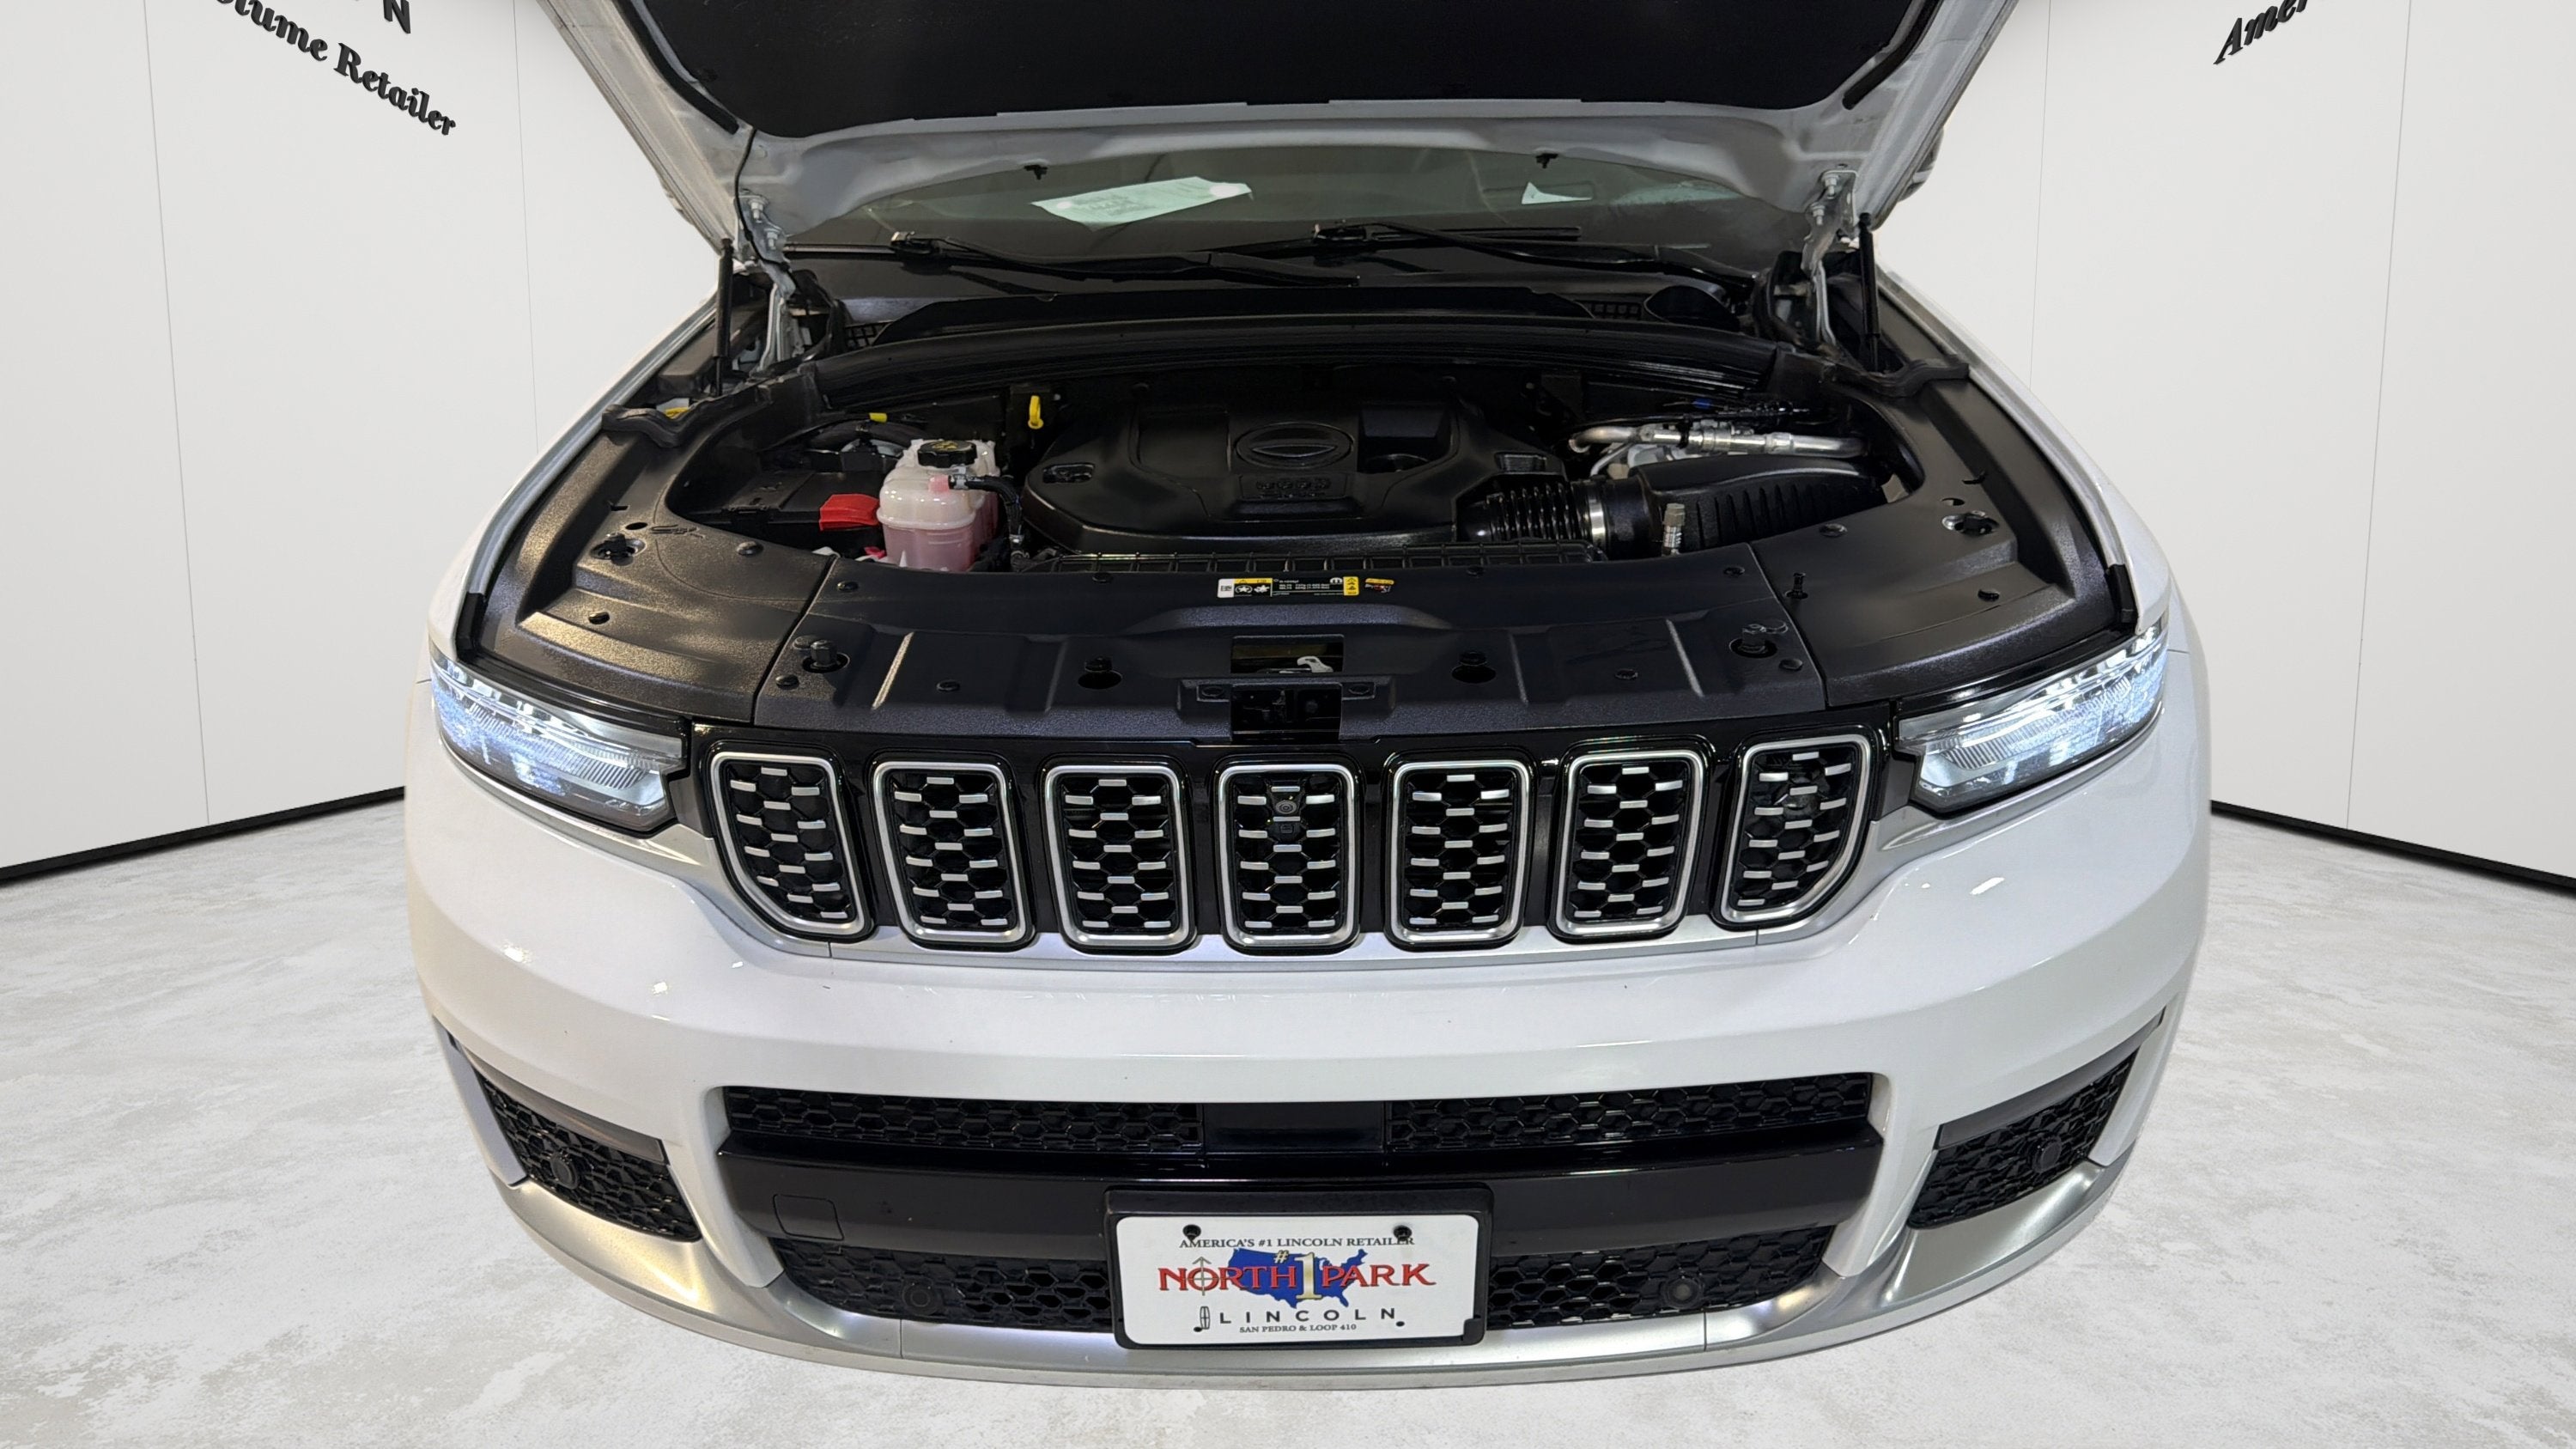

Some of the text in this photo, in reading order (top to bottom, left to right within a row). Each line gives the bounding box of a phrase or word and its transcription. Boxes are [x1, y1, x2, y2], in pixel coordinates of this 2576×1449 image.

[216, 0, 456, 136] ume Retailer
[1179, 1238, 1255, 1248] AMERICA'S
[1258, 1238, 1273, 1247] #1
[1277, 1237, 1343, 1247] LINCOLN
[1157, 1263, 1437, 1292] NORTH PARK
[1219, 1307, 1395, 1324] LINCOLN
[1239, 1325, 1260, 1334] SAN
[1261, 1324, 1297, 1333] PEDRO
